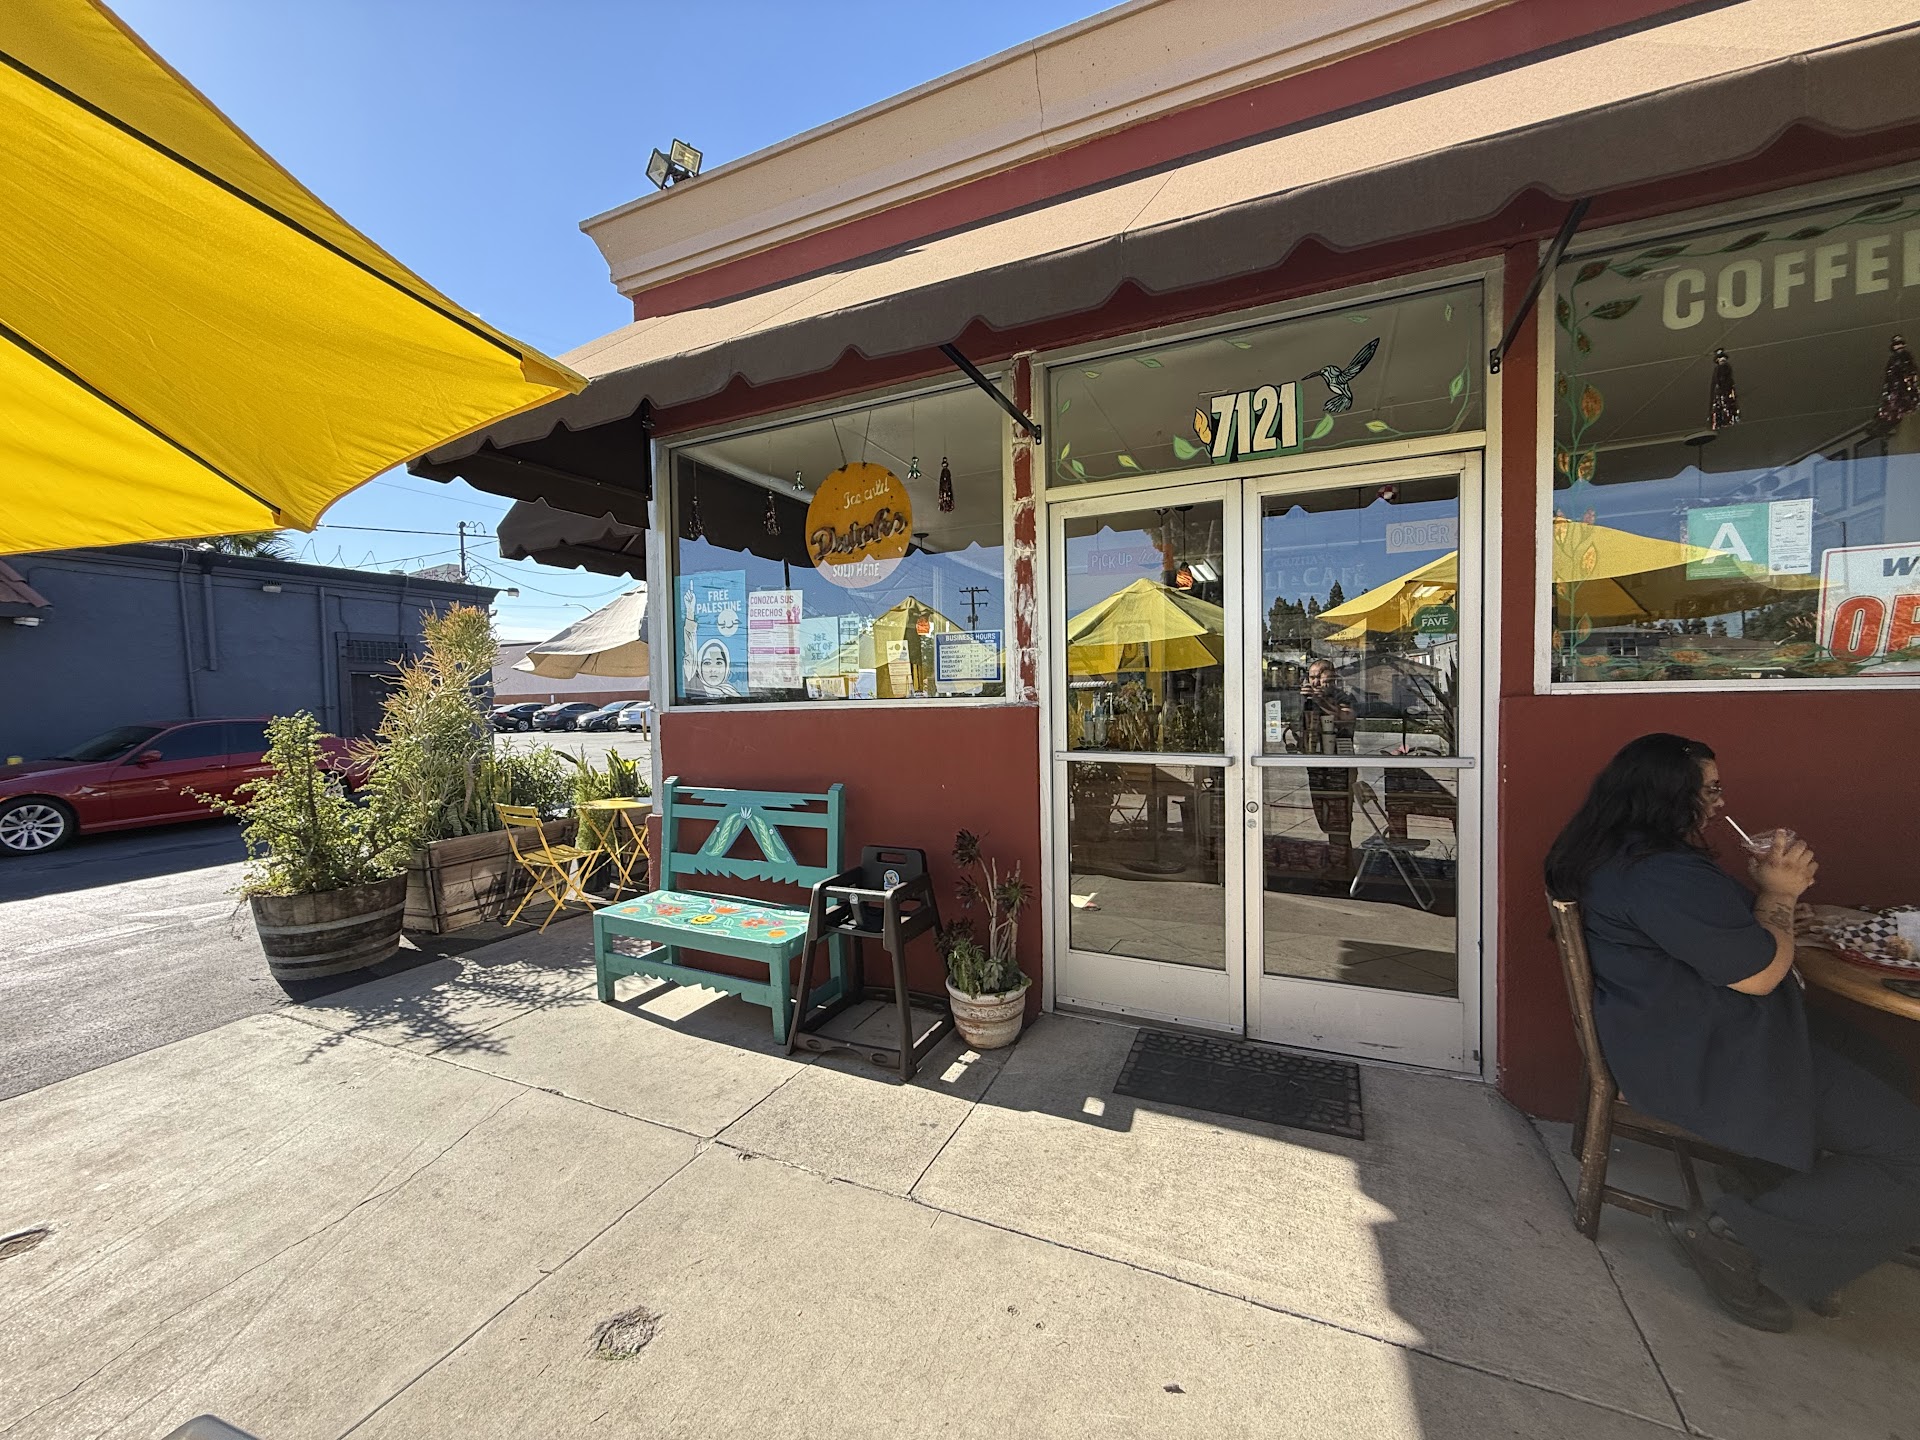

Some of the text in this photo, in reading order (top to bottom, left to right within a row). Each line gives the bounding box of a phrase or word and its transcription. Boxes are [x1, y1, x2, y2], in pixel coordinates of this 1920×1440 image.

[1209, 381, 1299, 459] 7121
[843, 491, 861, 509] Ice
[810, 507, 908, 561] Drinks
[1391, 524, 1450, 547] ORDER
[1701, 522, 1753, 565] A
[1090, 552, 1116, 571] PICK
[1117, 551, 1133, 568] UP
[832, 562, 880, 577] SOLD HERE
[707, 589, 730, 601] FREE
[750, 595, 794, 605] CONOZCA SUS
[696, 600, 742, 614] PALESTINE
[750, 608, 783, 618] DERECHOS
[1421, 616, 1449, 627] FAVE
[945, 632, 996, 641] BUSINESS HOURS
